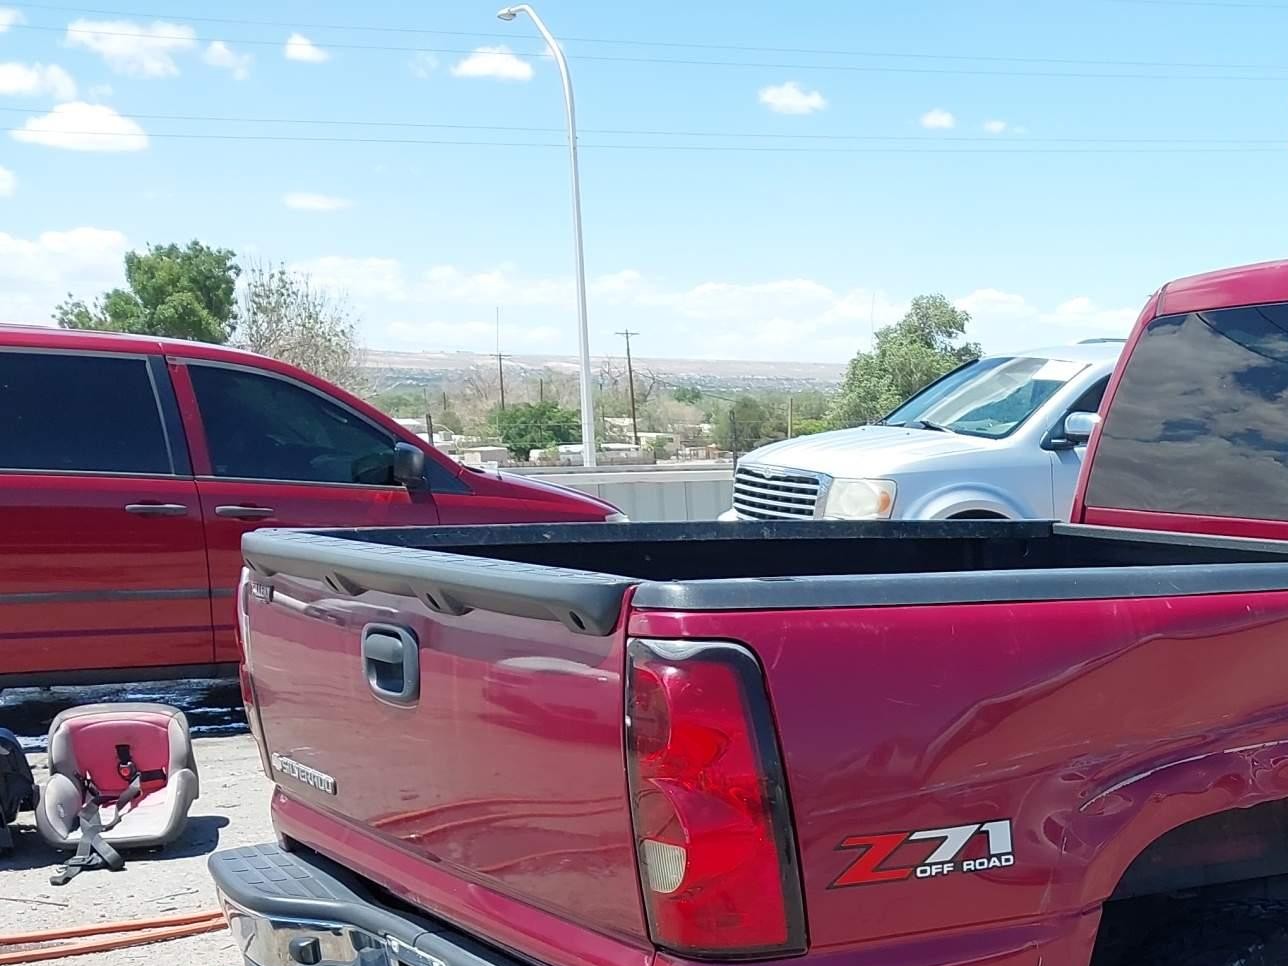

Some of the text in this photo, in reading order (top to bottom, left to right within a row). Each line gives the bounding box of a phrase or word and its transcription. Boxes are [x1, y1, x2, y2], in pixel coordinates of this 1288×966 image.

[281, 757, 334, 794] SILVERADO
[826, 817, 1014, 890] Z71
[915, 854, 1015, 879] OFF ROAD
